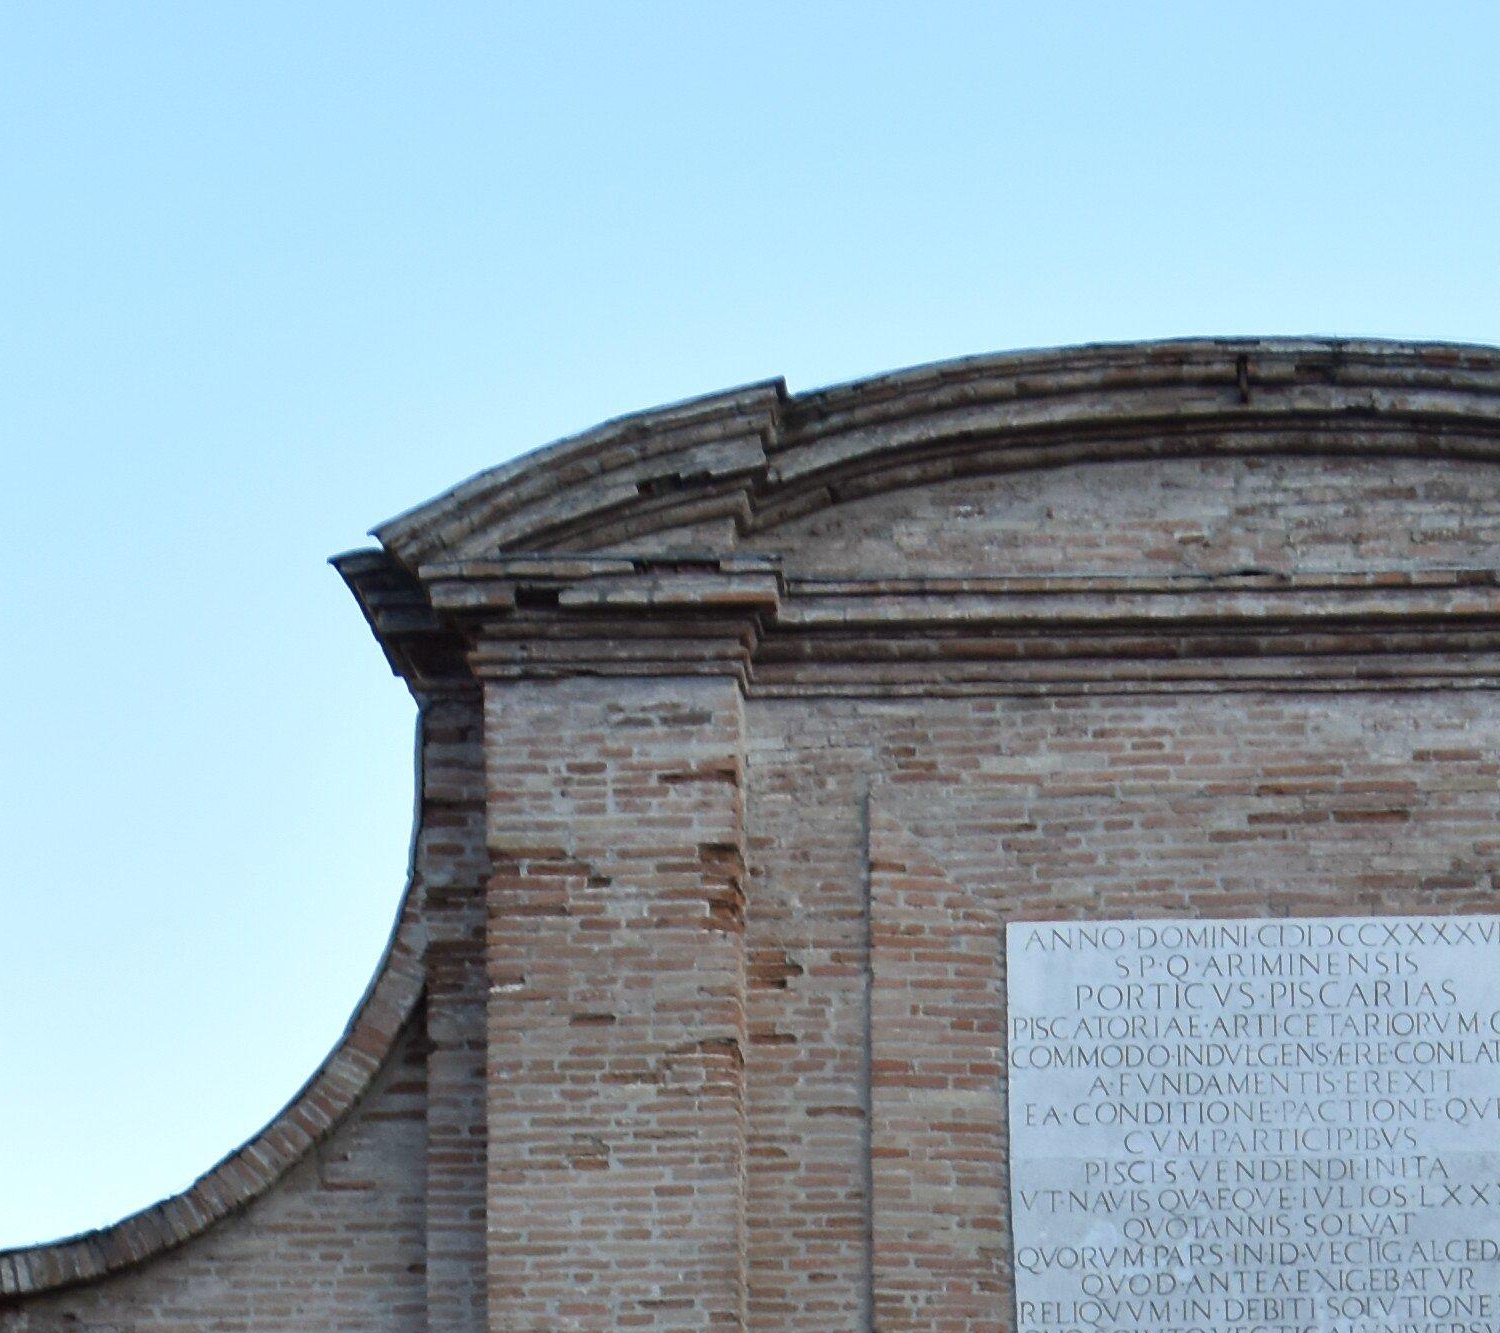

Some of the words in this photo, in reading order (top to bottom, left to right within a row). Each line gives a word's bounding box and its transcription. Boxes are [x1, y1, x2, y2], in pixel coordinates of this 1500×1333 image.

[1025, 927, 1125, 950] ANNO
[1137, 925, 1248, 949] DOMINI
[1202, 952, 1419, 978] ARIMINENSIS
[1076, 983, 1255, 1010] PORTICVS
[1270, 979, 1457, 1008] PISCARIAS
[1013, 1014, 1200, 1040] PISCATORIAE
[1011, 1044, 1170, 1069] COMMODO
[1177, 1042, 1328, 1068] INDVLGENS
[1120, 1071, 1336, 1096] FVNDAMENTIS
[1346, 1070, 1455, 1094] EREXIT
[1026, 1103, 1062, 1126] EA
[1073, 1100, 1272, 1126] CONDITIONE
[1124, 1130, 1199, 1154] CVM
[1212, 1128, 1417, 1153] PARTICIPIBVS
[1085, 1160, 1177, 1185] PISCIS
[1190, 1158, 1354, 1183] VENDENDI
[1365, 1156, 1449, 1180] INITA
[1019, 1190, 1062, 1212] VT
[1302, 1184, 1406, 1208] IVLIOS
[1304, 1212, 1416, 1237] SOLVAT
[1018, 1246, 1144, 1274] QVORVM
[1154, 1244, 1223, 1268] PARS
[1081, 1273, 1176, 1298] QVOD
[1186, 1270, 1289, 1294] ANTEA
[1297, 1267, 1475, 1292] EXIGEBATVR
[1021, 1301, 1171, 1328] RELIQVVM
[1182, 1299, 1211, 1321] IN
[1224, 1297, 1315, 1321] DEBITI
